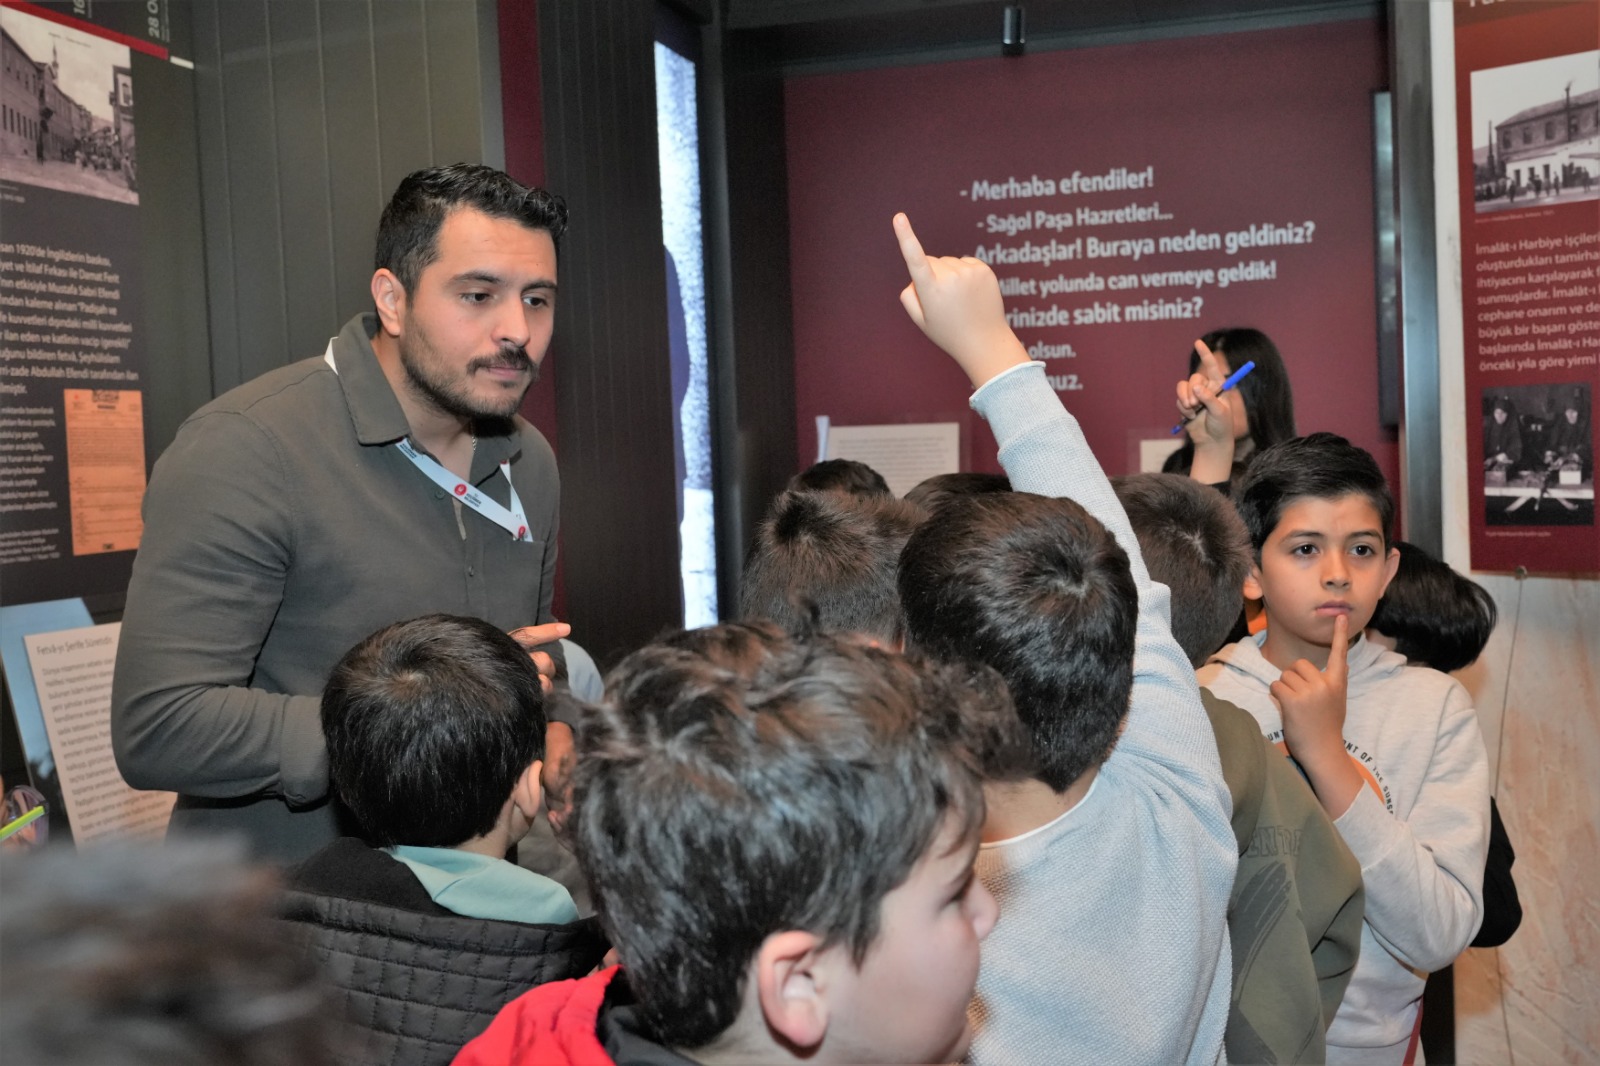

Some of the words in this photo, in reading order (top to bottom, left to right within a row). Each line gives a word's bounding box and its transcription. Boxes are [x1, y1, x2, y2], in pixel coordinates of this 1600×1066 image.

[147, 16, 160, 39] 28
[971, 174, 1056, 202] Merhaba
[1059, 165, 1154, 195] efendiler!
[986, 211, 1032, 237] Sağol
[1035, 209, 1074, 233] Paşa
[1076, 201, 1174, 227] Hazretleri...
[974, 238, 1082, 267] Arkadaşlar!
[1086, 235, 1155, 262] Buraya
[1159, 228, 1221, 253] neden
[1225, 220, 1316, 255] geldiniz?
[1519, 237, 1562, 250] Harbiye
[1476, 254, 1552, 273] oluşturdukları
[1555, 249, 1600, 264] tamirha
[1039, 271, 1105, 299] yolunda
[1108, 274, 1139, 290] can
[1141, 268, 1215, 290] vermeye
[1217, 259, 1277, 288] geldik!
[1476, 275, 1526, 290] ihtiyacını
[1528, 267, 1594, 285] karşılayarak
[1477, 287, 1551, 305] sunmuşlardır.
[1004, 305, 1070, 329] rinizde
[1073, 301, 1121, 326] sabit
[1124, 296, 1204, 322] misiniz?
[1477, 309, 1525, 323] cephane
[1526, 305, 1567, 318] onarım
[1569, 304, 1583, 315] ve
[1478, 325, 1512, 340] büyük
[1514, 323, 1529, 336] bir
[1531, 322, 1566, 336] başarı
[1027, 340, 1077, 360] olsun.
[1478, 341, 1536, 356] başlarında
[1479, 358, 1515, 372] önceki
[1517, 356, 1537, 372] yıla
[1539, 355, 1565, 371] göre
[1566, 353, 1597, 369] yirmi
[1360, 751, 1373, 764] OF
